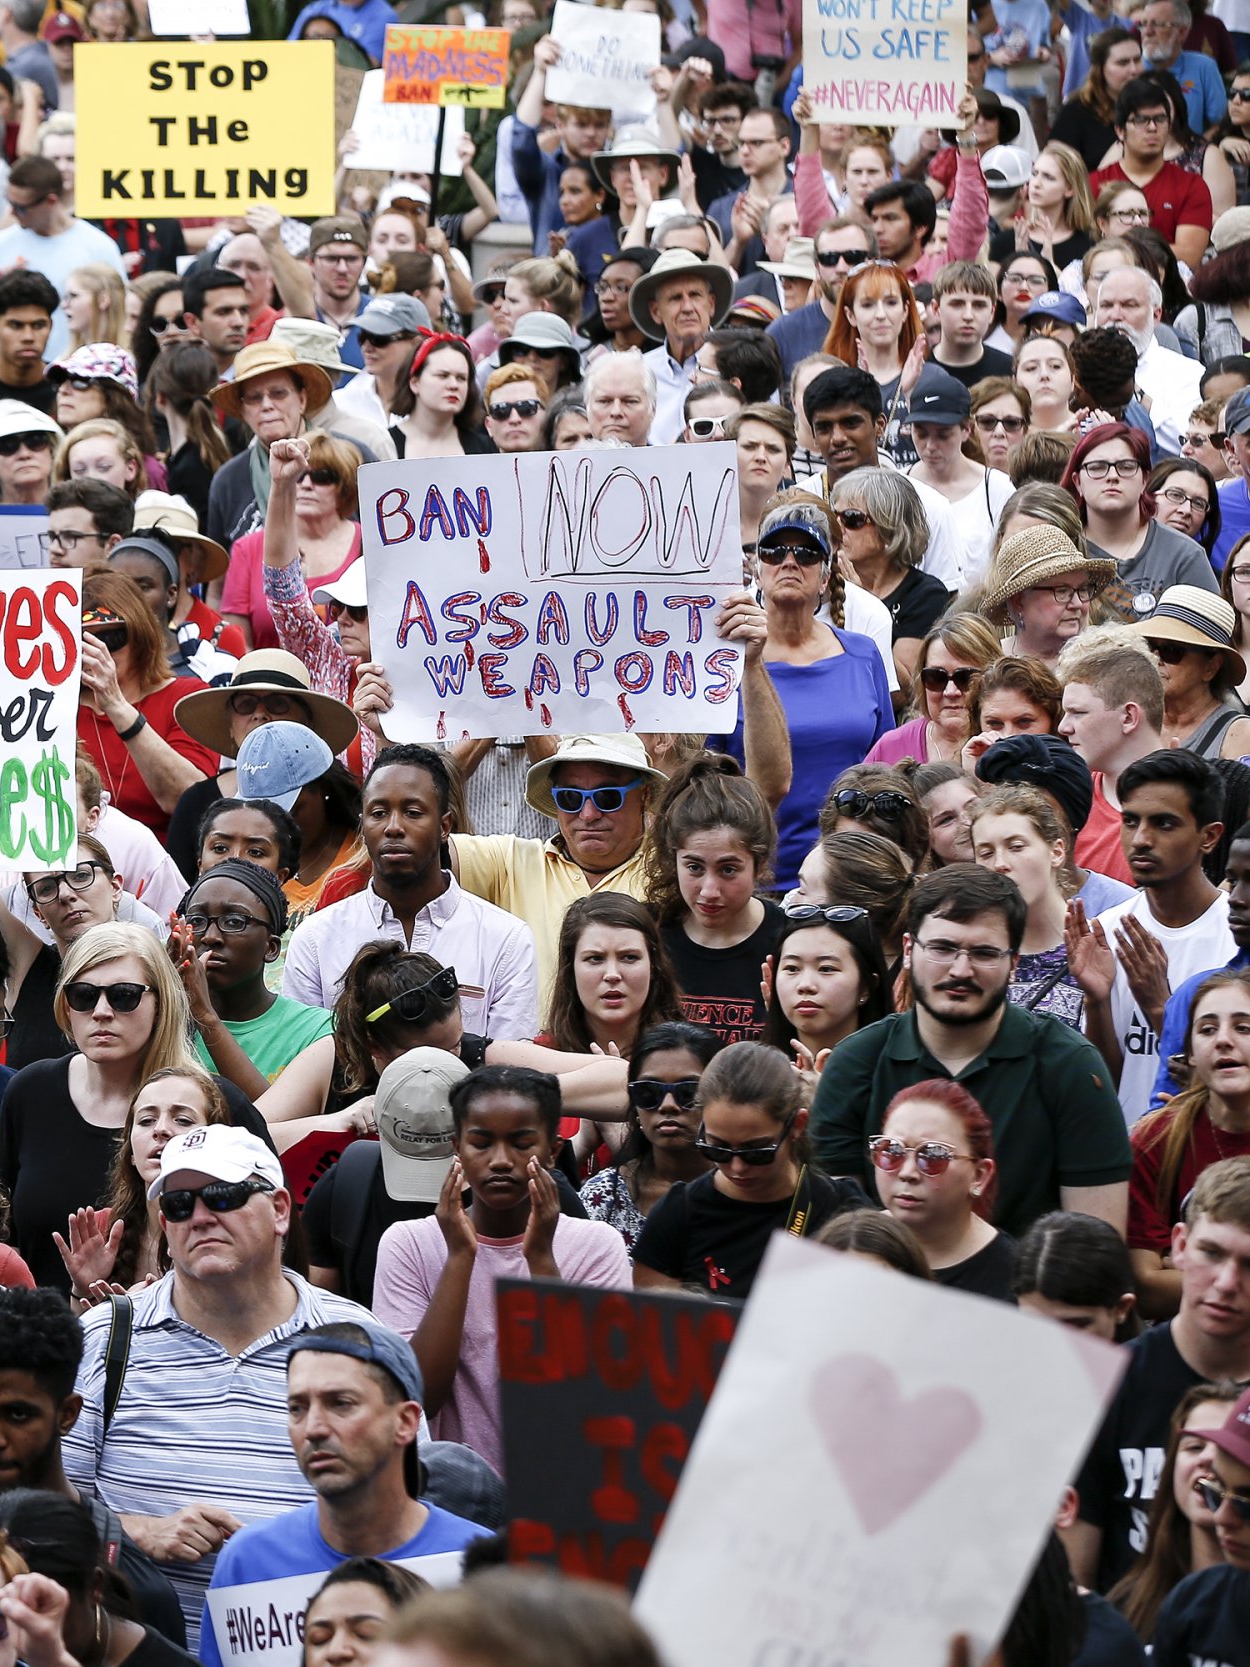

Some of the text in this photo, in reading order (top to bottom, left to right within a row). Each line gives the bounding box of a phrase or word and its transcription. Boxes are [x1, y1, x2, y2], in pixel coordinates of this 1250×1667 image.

[891, 0, 954, 23] KEEP
[386, 29, 501, 51] STOP THE
[597, 35, 621, 55] DO
[820, 27, 951, 61] US SAFE
[386, 47, 503, 87] MADNESS
[396, 85, 432, 101] BAN
[814, 79, 956, 120] #NEVERAGAIN
[376, 456, 735, 576] BAN NOW
[397, 580, 716, 650] ASSAULT
[424, 648, 740, 704] WEAPONS
[678, 1001, 754, 1026] IENCE
[401, 1133, 423, 1144] RELAY
